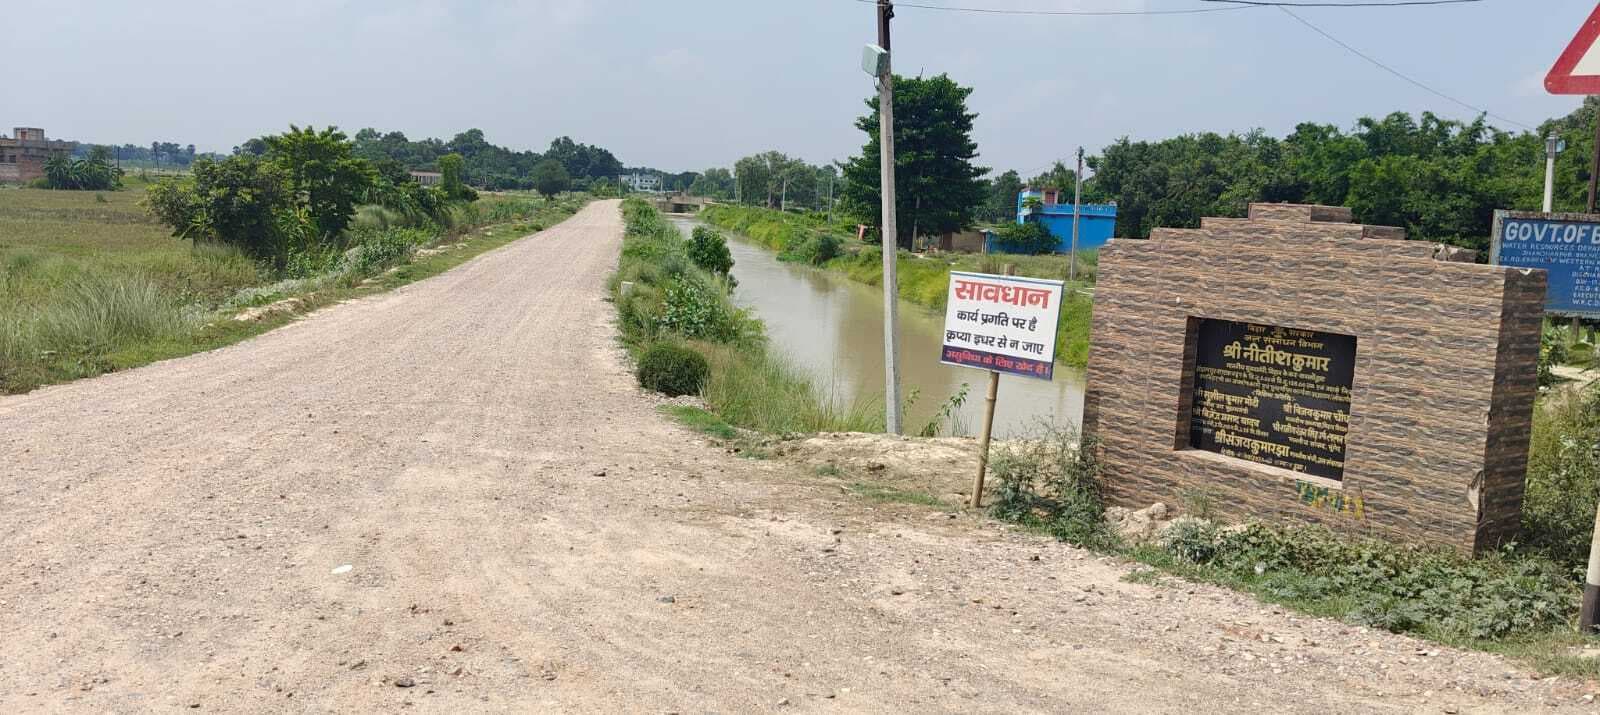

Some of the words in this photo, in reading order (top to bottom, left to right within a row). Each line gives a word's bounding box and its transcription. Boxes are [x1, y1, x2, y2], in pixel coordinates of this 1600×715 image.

[955, 280, 1052, 309] सावधान
[957, 309, 979, 322] कार्य
[981, 312, 1009, 326] प्रगति
[1012, 317, 1027, 329] पर
[1028, 316, 1037, 331] है
[973, 334, 995, 346] इधर
[997, 335, 1007, 348] से
[1010, 339, 1019, 350] न
[1022, 341, 1045, 354] जाए
[1223, 341, 1242, 359] श्री
[1298, 338, 1324, 350] विभाग
